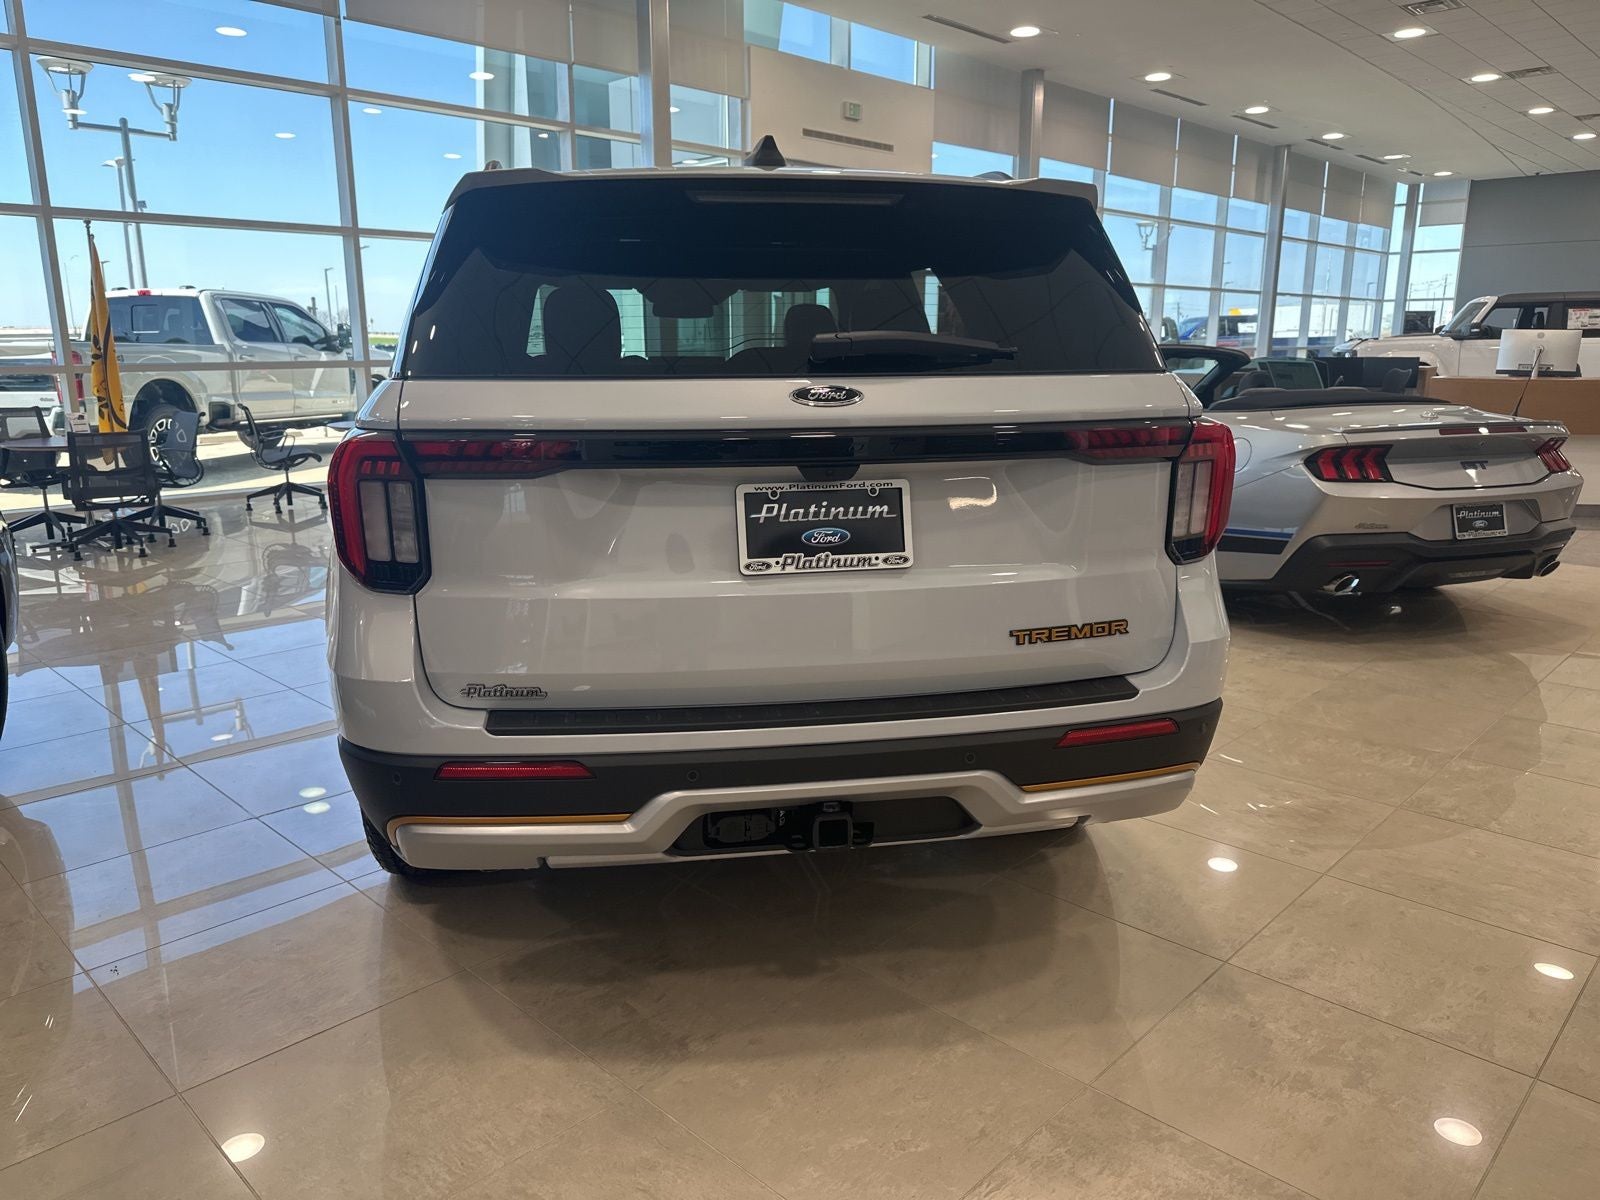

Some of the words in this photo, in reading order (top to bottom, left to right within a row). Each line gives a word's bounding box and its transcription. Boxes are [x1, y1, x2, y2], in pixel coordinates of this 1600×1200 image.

[806, 387, 849, 401] Ford
[754, 481, 894, 492] www.PlatinumFord.com
[749, 501, 897, 524] Platinum
[1457, 509, 1503, 520] Platinum
[809, 529, 842, 545] Ford
[780, 552, 880, 572] Platinum
[1009, 618, 1129, 645] TREMOR
[460, 683, 548, 699] Platinum
